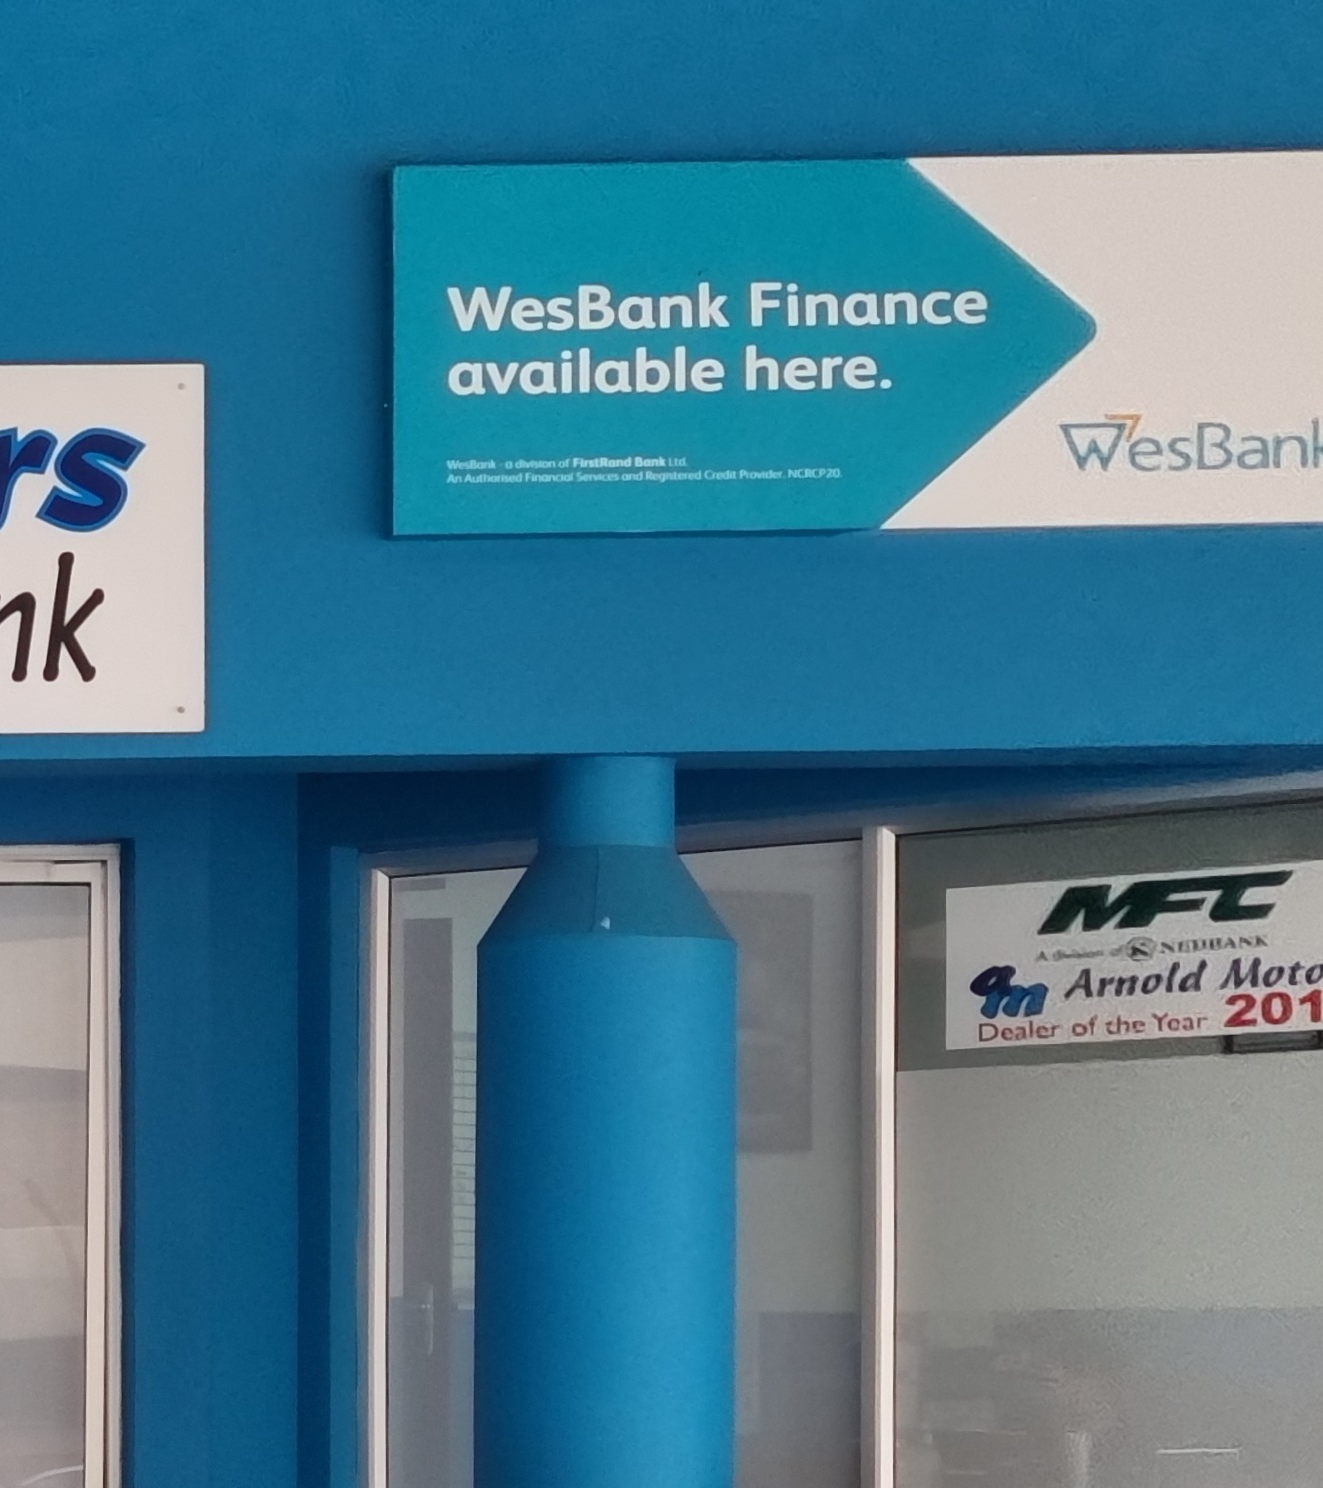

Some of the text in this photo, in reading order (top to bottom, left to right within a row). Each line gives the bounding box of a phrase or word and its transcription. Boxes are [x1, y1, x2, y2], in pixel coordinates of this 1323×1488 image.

[447, 280, 989, 332] WesBank Finance
[447, 344, 893, 396] available here.
[446, 459, 497, 470] WesBank
[515, 458, 555, 469] division
[558, 457, 570, 468] of
[572, 456, 632, 468] FirstRand
[634, 456, 666, 468] Bank
[446, 473, 462, 484] An
[463, 472, 523, 483] Authorised
[525, 471, 574, 483] Financial
[575, 471, 619, 482] Services
[621, 470, 643, 482] and
[645, 470, 702, 483] Registered
[704, 469, 736, 480] Credit
[1037, 869, 1294, 935] MFC
[1064, 958, 1208, 1000] Arnold
[978, 988, 1323, 1043] Dealer of the Year 201
